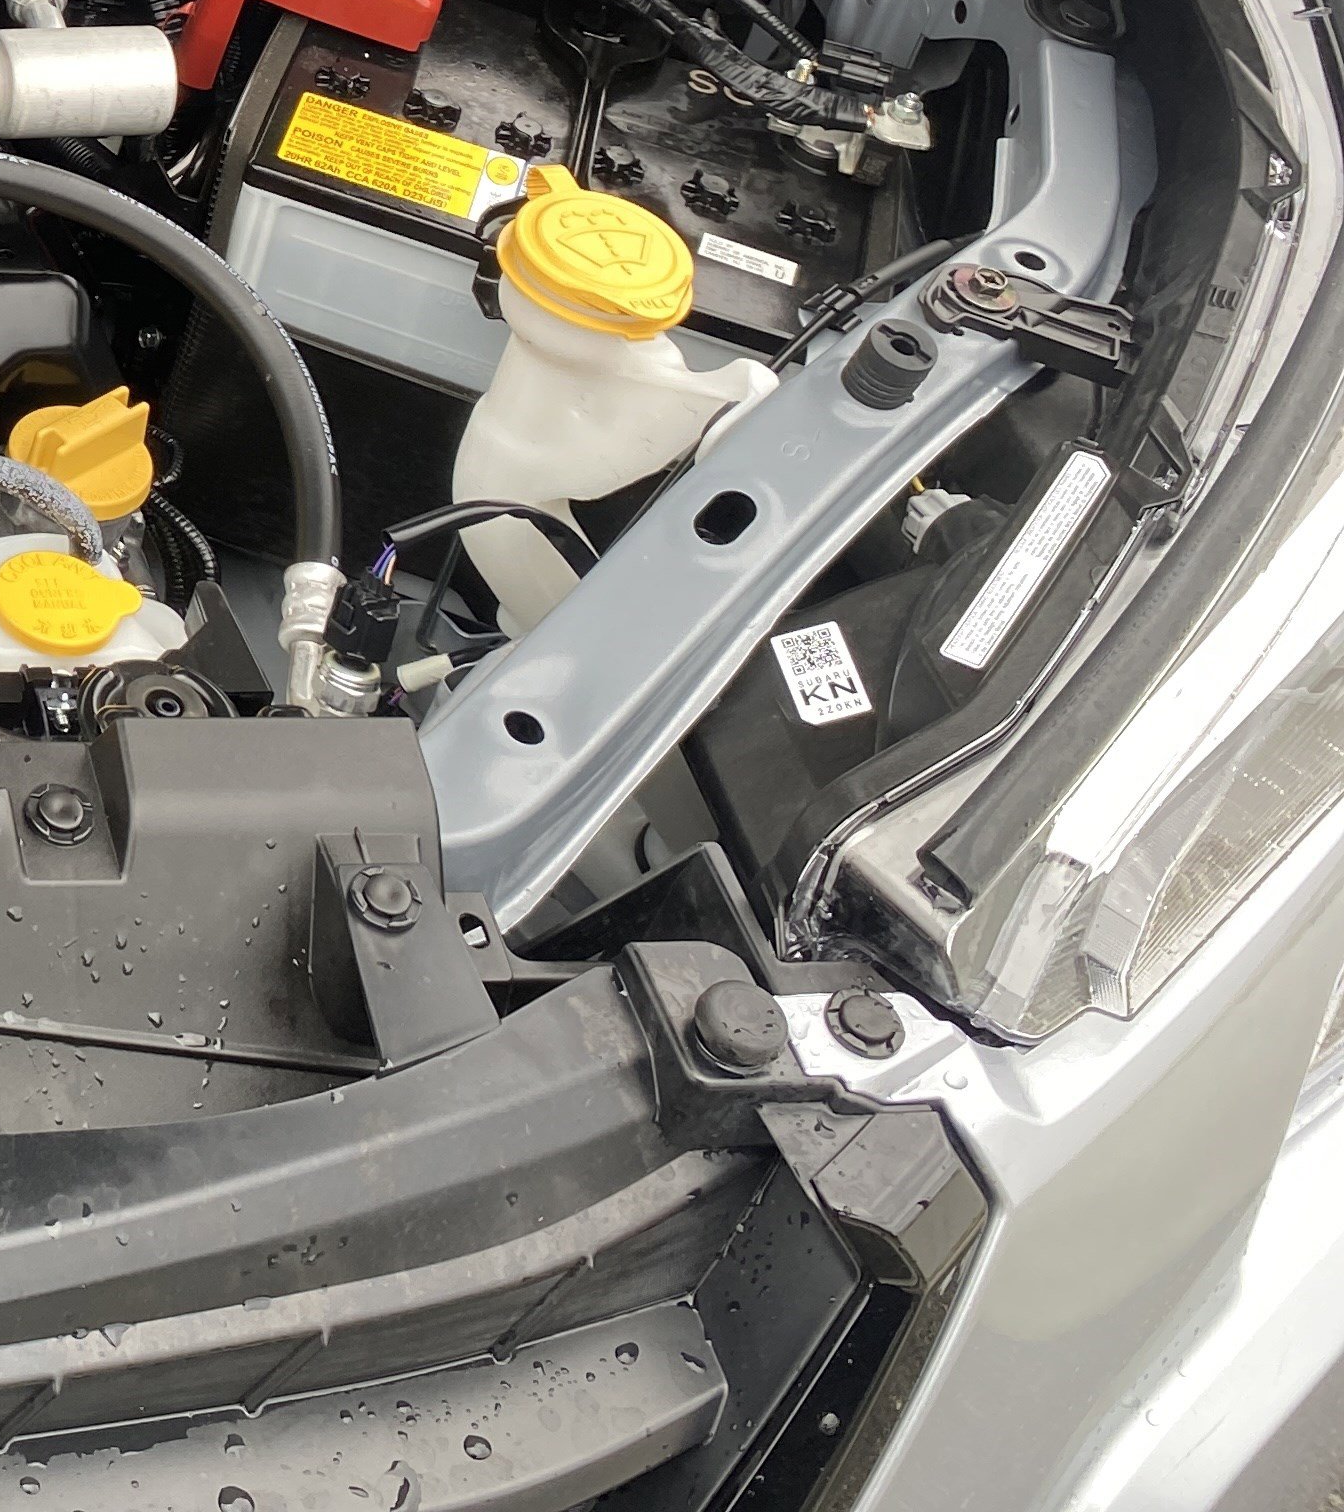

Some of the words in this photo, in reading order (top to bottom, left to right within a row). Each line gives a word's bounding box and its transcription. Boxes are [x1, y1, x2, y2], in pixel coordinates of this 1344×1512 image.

[306, 96, 358, 118] DANGER
[292, 126, 344, 148] POISON
[345, 170, 369, 184] CCA
[628, 298, 673, 311] PULL
[797, 670, 851, 689] SUBARU
[800, 677, 859, 706] KN
